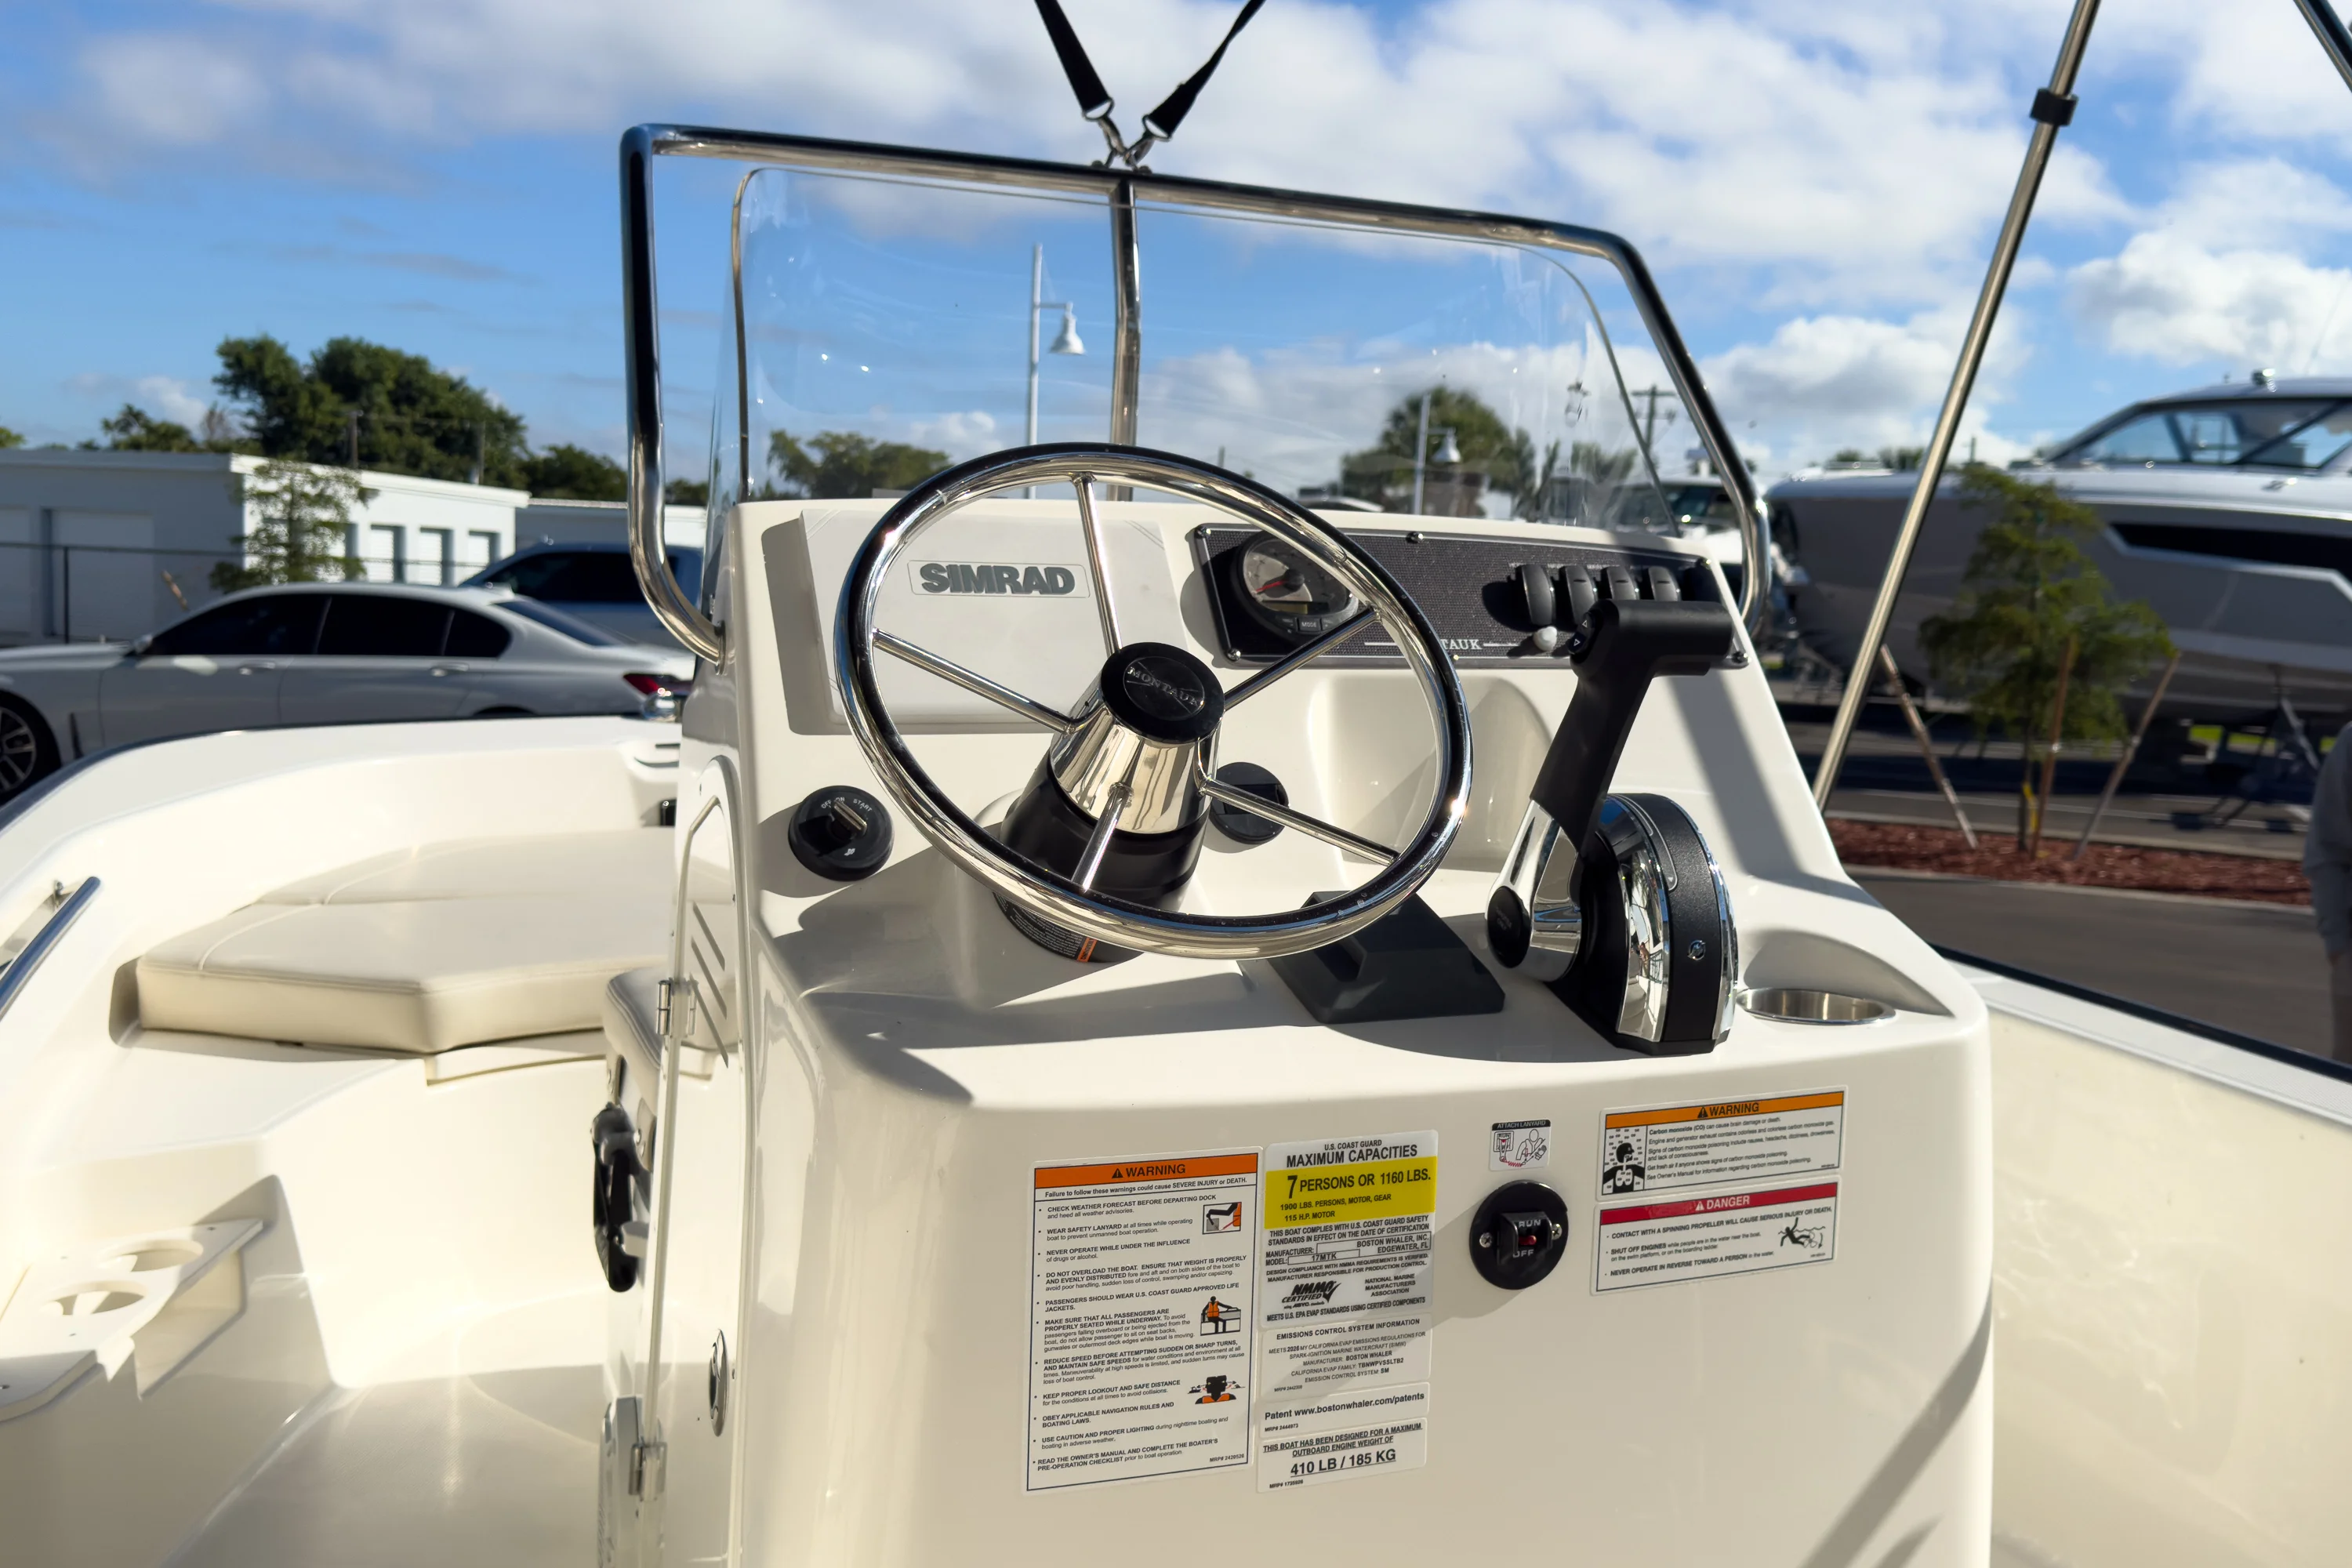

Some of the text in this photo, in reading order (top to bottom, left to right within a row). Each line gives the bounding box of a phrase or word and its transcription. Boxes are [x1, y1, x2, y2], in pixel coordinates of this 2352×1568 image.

[920, 562, 1076, 596] SIMRAD
[1440, 639, 1483, 650] TAUK
[821, 799, 832, 809] OFF
[853, 798, 873, 812] START
[1709, 1103, 1759, 1116] WARNING
[1337, 1141, 1359, 1149] COAST
[1359, 1139, 1382, 1148] GUARD
[1287, 1144, 1417, 1168] MAXIMUM CAPACITIES
[1125, 1163, 1186, 1177] WARNING
[1109, 1185, 1136, 1194] warnings
[1287, 1175, 1298, 1200] 7
[1299, 1174, 1355, 1192] PERSONS
[1358, 1173, 1375, 1187] OR
[1380, 1171, 1404, 1185] 1160
[1374, 1193, 1392, 1202] GEAR
[1706, 1196, 1750, 1210] DANGER
[1312, 1210, 1335, 1219] MOTOR
[1302, 1225, 1334, 1234] COMPLIES
[1384, 1218, 1406, 1226] GUARD
[1406, 1215, 1428, 1224] SAFETY
[1518, 1219, 1541, 1228] RUN
[1611, 1230, 1640, 1240] CONTACT
[1662, 1224, 1690, 1233] SPINNING
[1690, 1220, 1724, 1230] PROPELLER
[1759, 1213, 1784, 1221] SERIOUS
[1784, 1210, 1804, 1218] INJURY
[1268, 1236, 1305, 1246] STANDARDS
[1313, 1232, 1337, 1241] EFFECT
[1386, 1223, 1429, 1234] CERTIFICATION
[1156, 1238, 1191, 1247] INFLUENCE
[1356, 1238, 1385, 1248] BOSTON
[1512, 1249, 1534, 1258] OFF
[1071, 1267, 1106, 1276] OVERLOAD
[1045, 1296, 1087, 1305] PASSENGERS
[1192, 1283, 1226, 1292] APPROVED
[1281, 1293, 1322, 1304] CERTIFIED
[1276, 1319, 1420, 1340] EMISSIONS CONTROL SYSTEM INFORMATION
[1151, 1379, 1181, 1388] DISTANCE
[1061, 1410, 1100, 1419] APPLICABLE
[1101, 1405, 1139, 1414] NAVIGATION
[1265, 1392, 1425, 1420] Patent www.bostonwhaler.com/patents
[1042, 1419, 1071, 1428] BOATING
[1263, 1443, 1279, 1452] THIS
[1279, 1440, 1299, 1450] BOAT
[1299, 1438, 1314, 1446] HAS
[1315, 1436, 1334, 1444] BEEN
[1334, 1430, 1369, 1442] DESIGNED
[1390, 1423, 1422, 1434] MAXIMUM
[1292, 1445, 1331, 1457] OUTBOARD
[1330, 1441, 1357, 1451] ENGINE
[1357, 1438, 1384, 1448] WEIGHT
[1290, 1448, 1396, 1475] 410 LB / 185 KG
